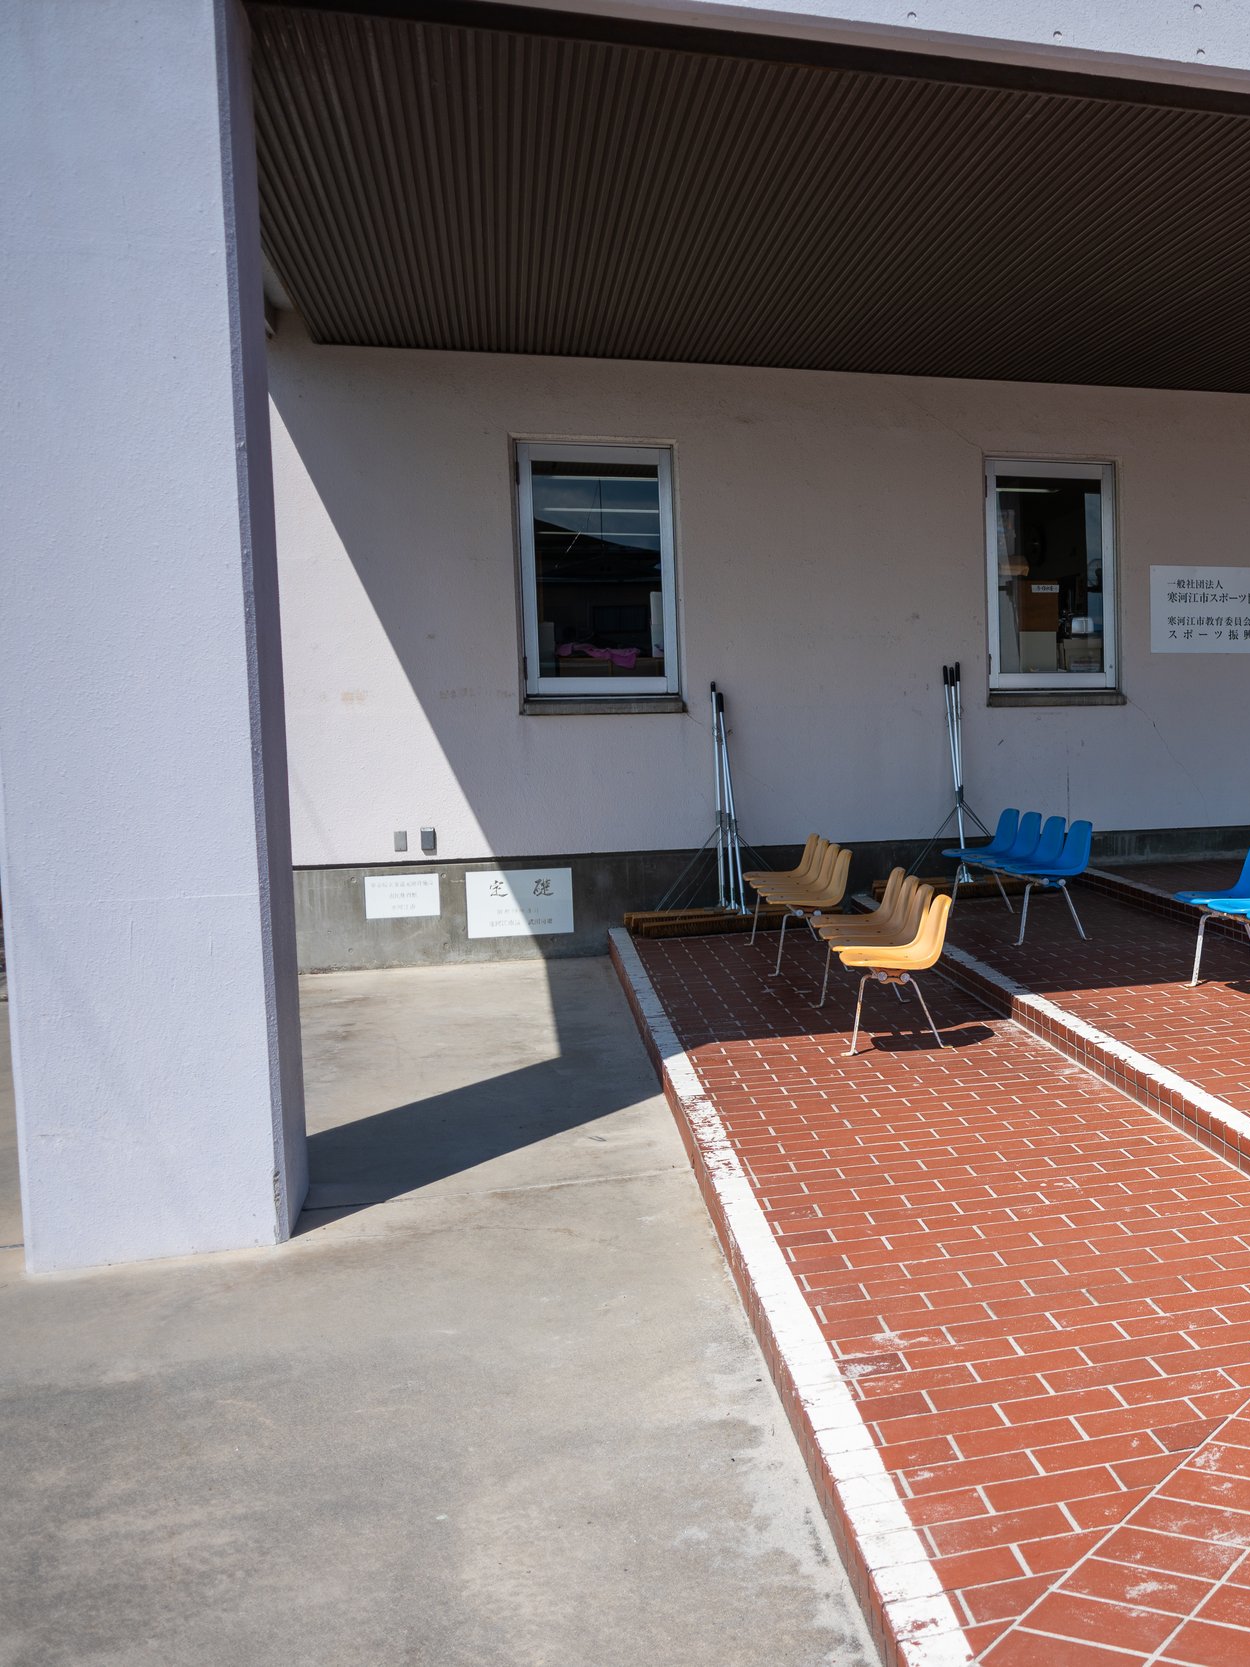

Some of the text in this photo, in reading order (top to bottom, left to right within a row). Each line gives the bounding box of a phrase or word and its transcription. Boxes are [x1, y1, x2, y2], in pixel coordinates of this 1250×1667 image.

[1167, 579, 1223, 589] 一般社団法人
